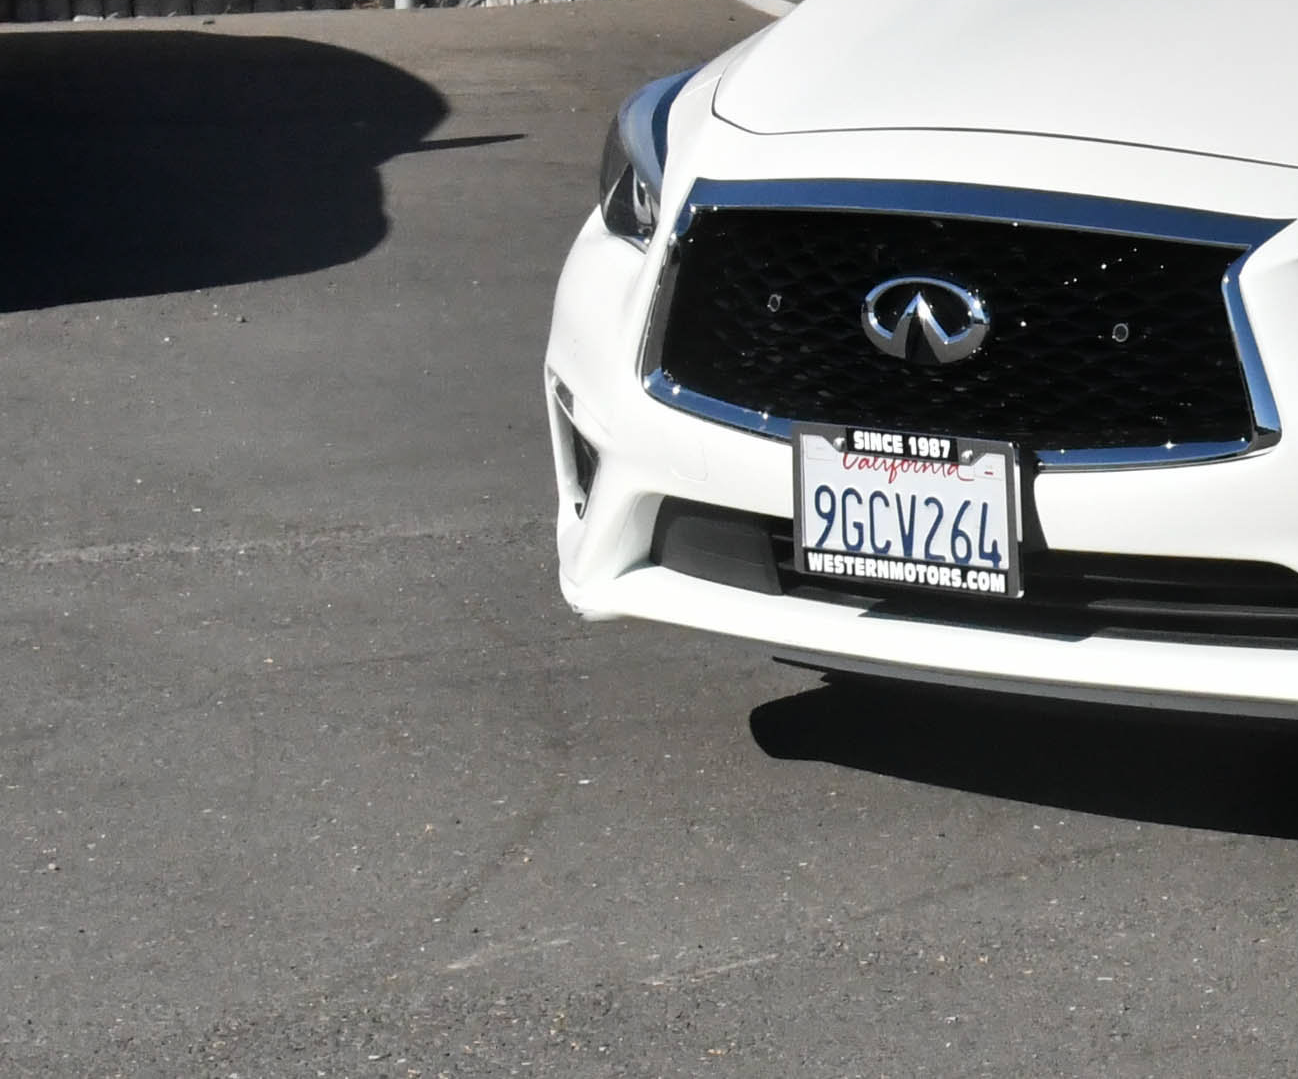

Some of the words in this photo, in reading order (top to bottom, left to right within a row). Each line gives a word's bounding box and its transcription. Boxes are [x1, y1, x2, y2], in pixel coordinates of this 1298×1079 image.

[853, 430, 903, 454] SINCE
[908, 436, 951, 458] 1987
[815, 484, 1002, 568] 9GCV264
[808, 552, 1006, 593] WESTERNMOTORS.COM
